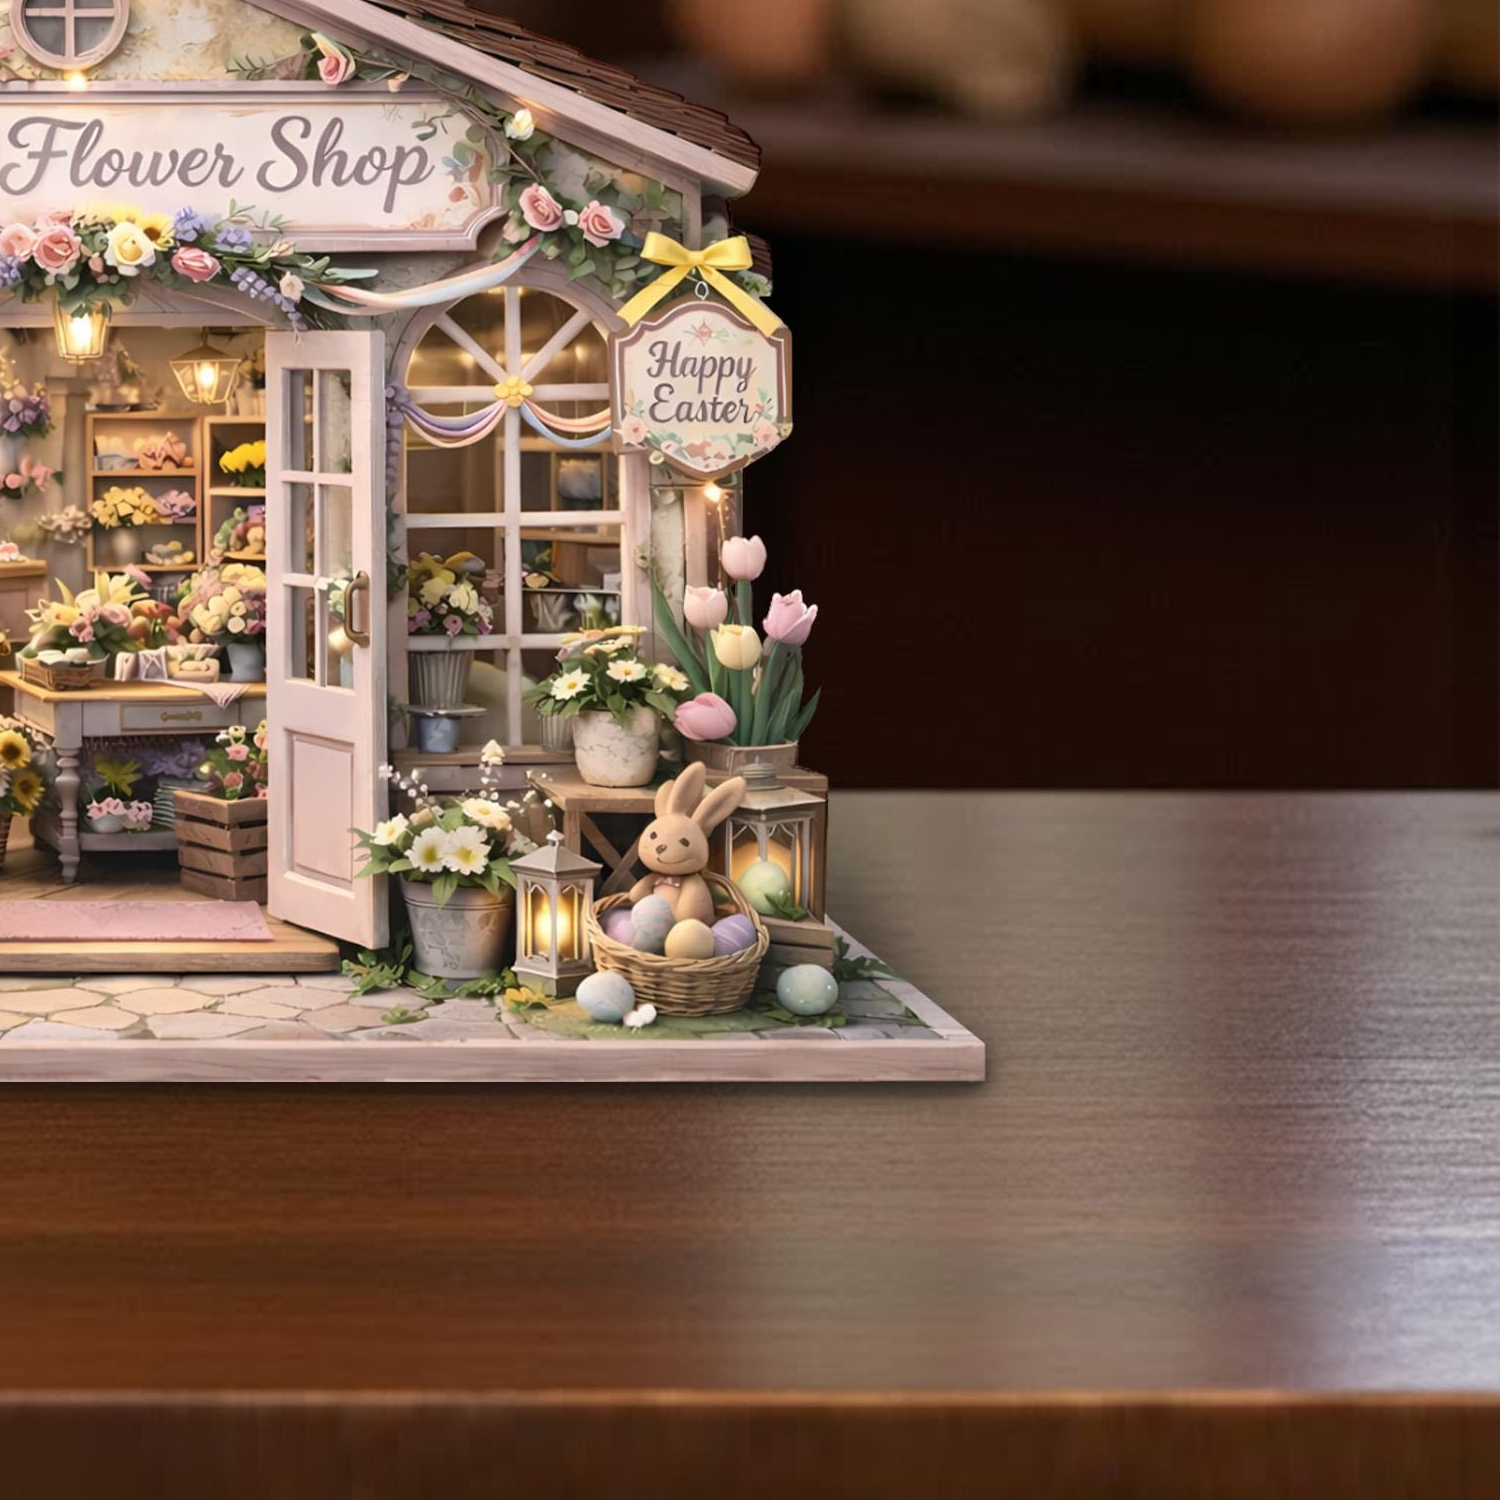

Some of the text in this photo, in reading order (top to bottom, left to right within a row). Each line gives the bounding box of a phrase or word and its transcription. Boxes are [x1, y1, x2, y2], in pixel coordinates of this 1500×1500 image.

[256, 115, 436, 214] Shop
[646, 340, 757, 395] Happy
[649, 383, 757, 424] Easter
